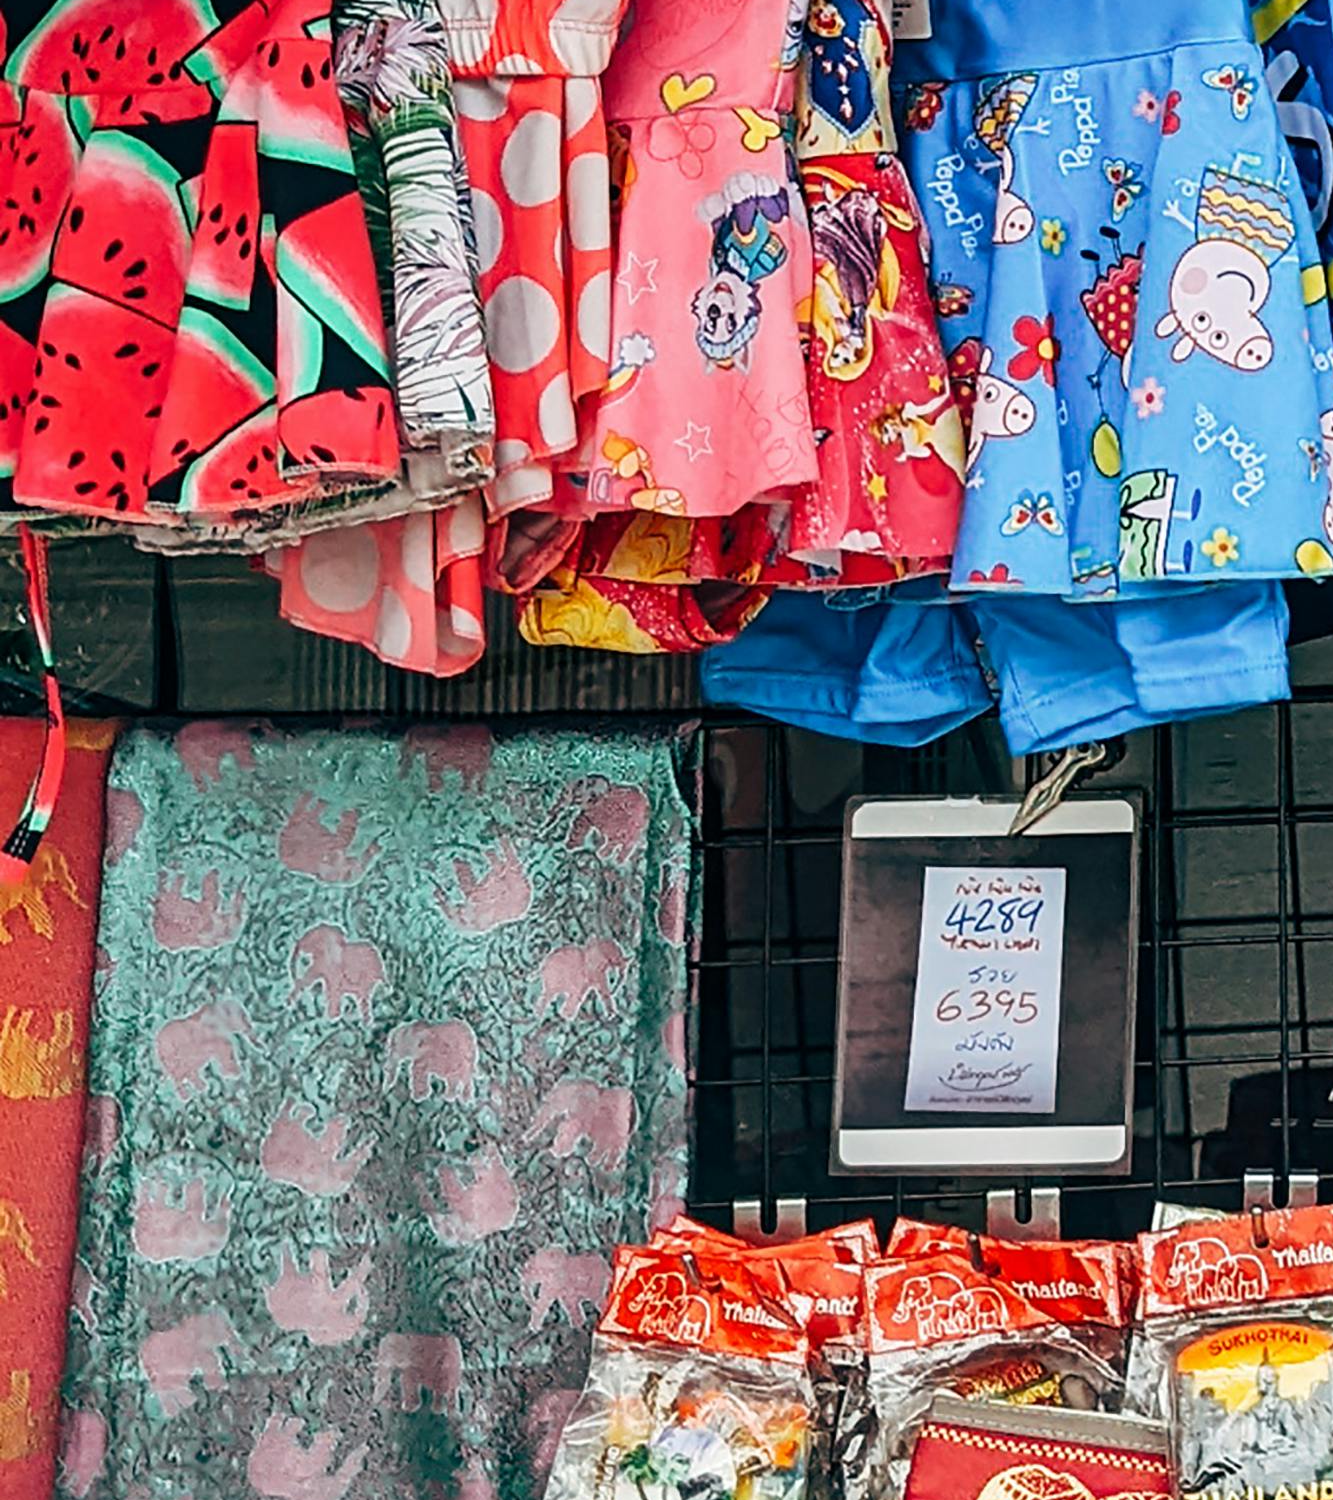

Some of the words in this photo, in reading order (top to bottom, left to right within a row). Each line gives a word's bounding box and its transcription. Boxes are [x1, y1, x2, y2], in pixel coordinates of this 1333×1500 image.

[1058, 96, 1098, 175] Peppa
[927, 154, 965, 227] Peppa
[1219, 424, 1267, 507] Peppa
[945, 897, 1044, 936] 4289
[936, 990, 1039, 1024] 6395
[1012, 1279, 1103, 1301] Thailand
[1209, 1329, 1308, 1357] SUKHOTHAI
